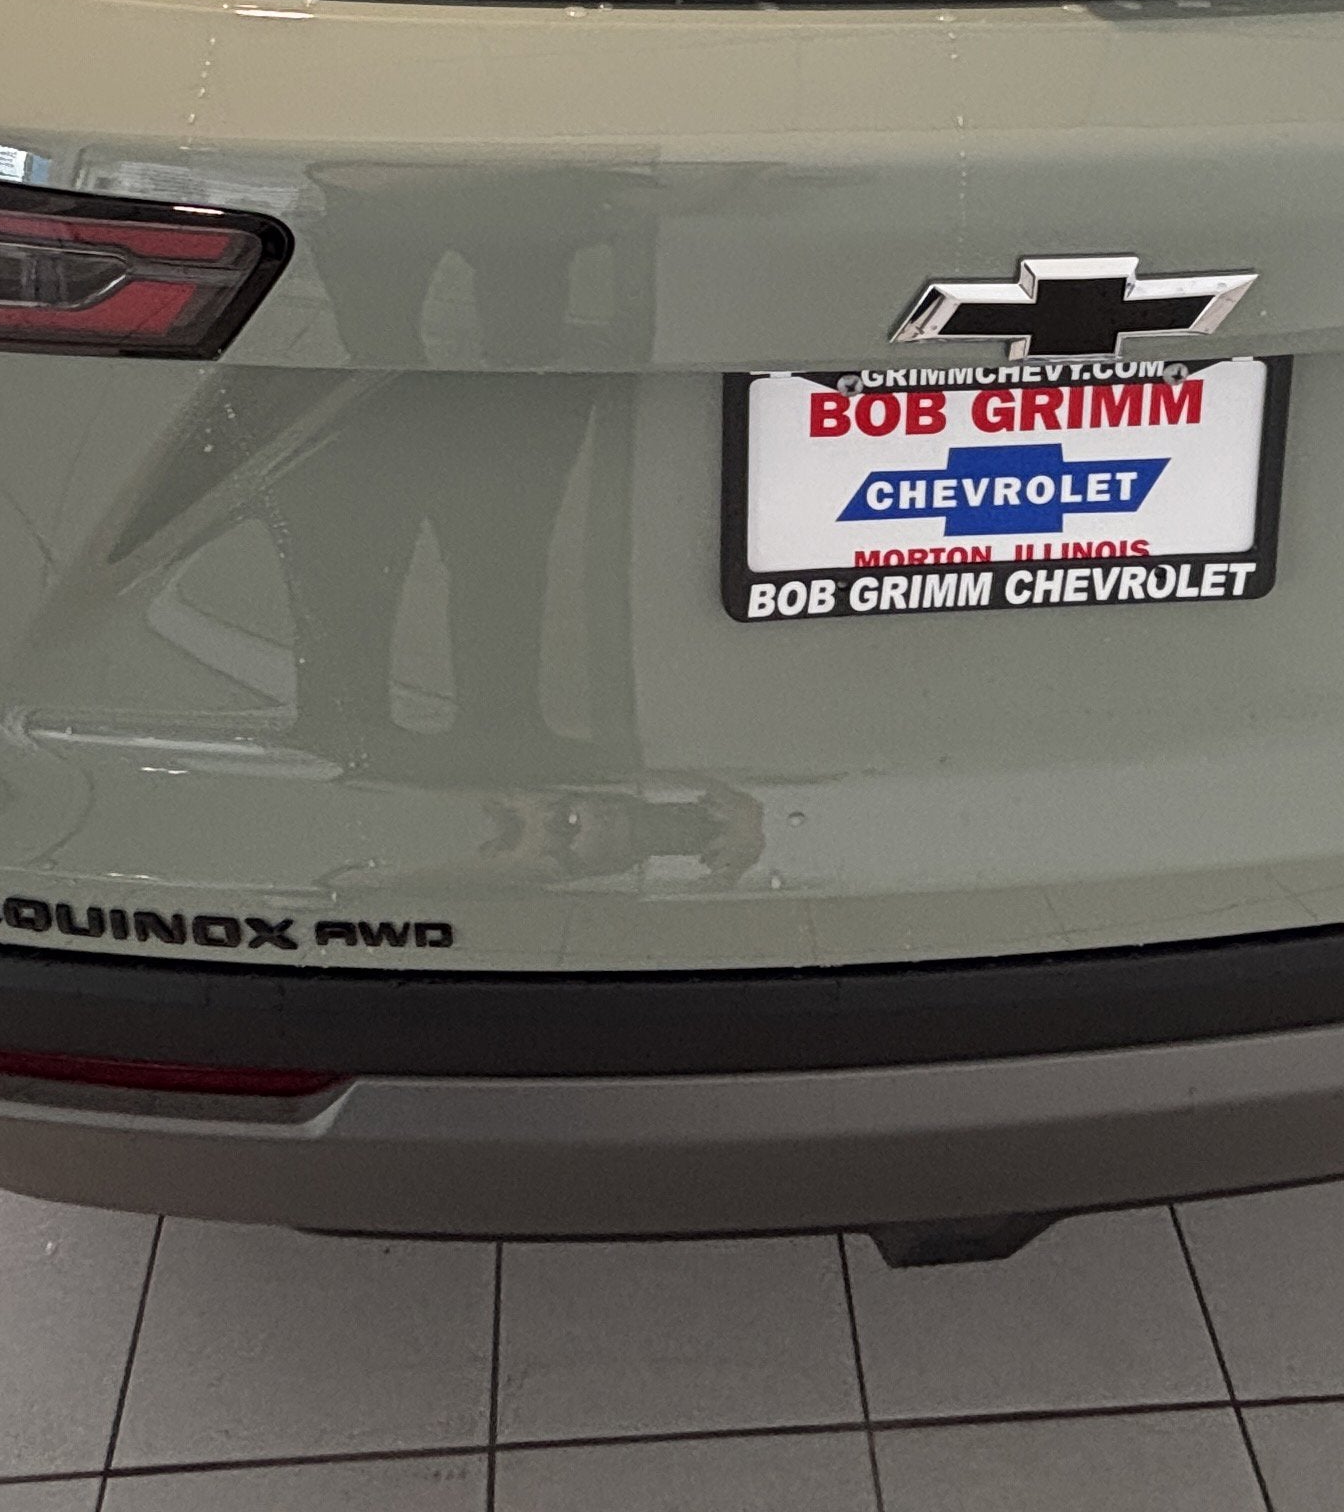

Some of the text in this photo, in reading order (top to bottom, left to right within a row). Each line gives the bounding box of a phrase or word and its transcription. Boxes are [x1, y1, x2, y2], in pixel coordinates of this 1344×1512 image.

[860, 360, 1165, 387] GRIMMCHEVY.COM
[810, 379, 1204, 437] BOB GRIMM
[866, 471, 1138, 510] CHEVROLET
[854, 546, 992, 569] MORTON
[747, 562, 1256, 619] BOB GRIMM CHEVROLET
[314, 920, 454, 949] AWD
